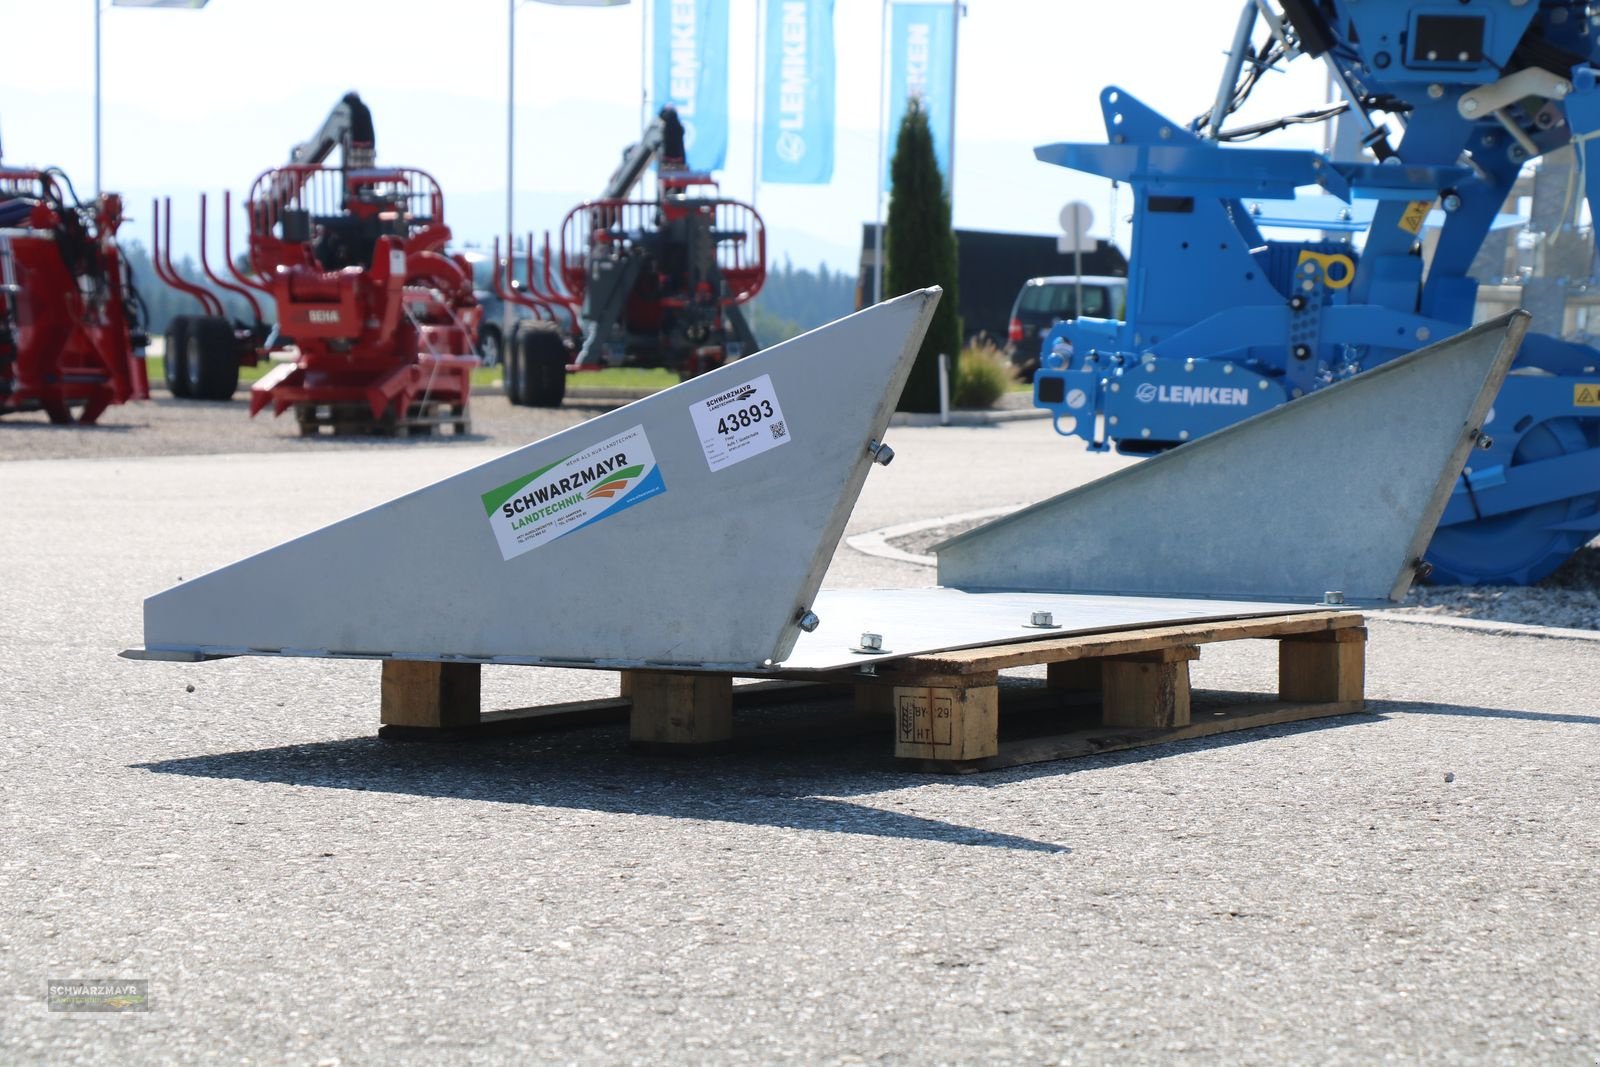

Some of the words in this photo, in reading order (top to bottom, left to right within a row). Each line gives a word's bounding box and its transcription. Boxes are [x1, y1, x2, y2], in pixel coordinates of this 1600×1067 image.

[670, 0, 698, 117] LEMKE
[779, 2, 807, 130] LEMKEN
[706, 384, 751, 408] SCHWARZMAYR
[709, 398, 735, 412] LANDTECHNIK
[1158, 384, 1249, 406] LEMKEN
[717, 399, 774, 435] 43893
[566, 457, 580, 467] MEHR
[581, 452, 591, 461] ALS
[592, 447, 602, 456] NUR
[502, 452, 628, 518] SCHWARZMAYR
[511, 492, 585, 531] LANDTECHNIK
[916, 729, 930, 739] HT
